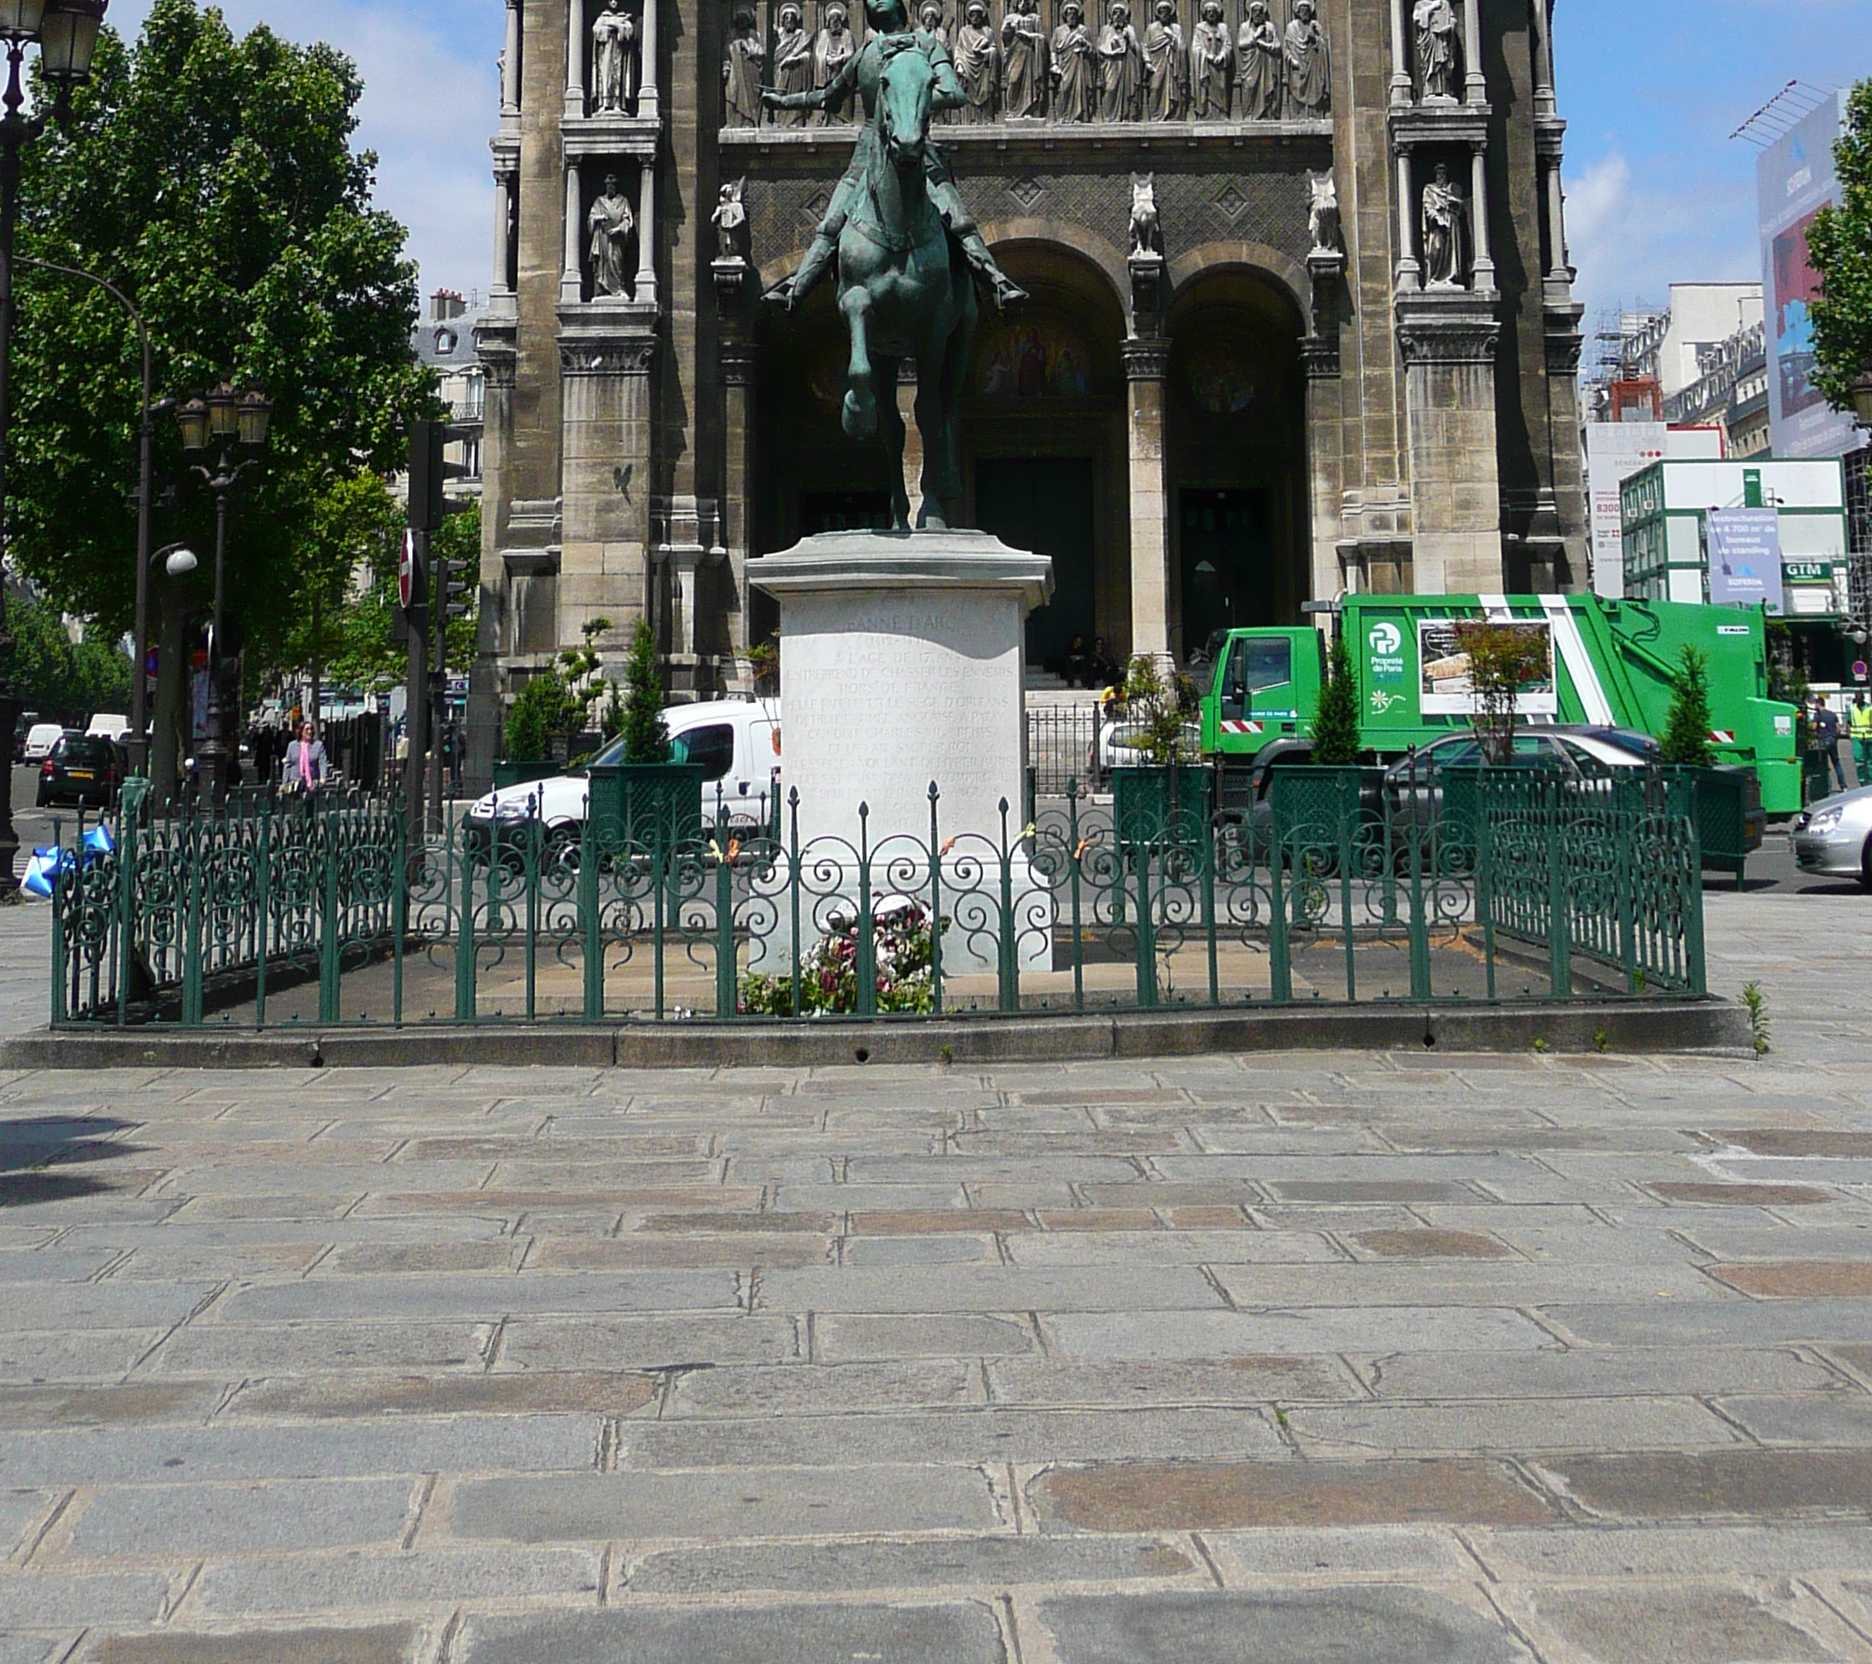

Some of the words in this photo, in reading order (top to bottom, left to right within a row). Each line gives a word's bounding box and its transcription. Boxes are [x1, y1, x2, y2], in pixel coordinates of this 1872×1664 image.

[1723, 524, 1730, 533] 4
[1732, 524, 1749, 533] 700
[1764, 524, 1776, 533] de
[1725, 535, 1761, 544] bureaux
[1732, 546, 1770, 556] standing
[1786, 564, 1822, 575] GTM
[893, 651, 911, 665] DE
[1370, 656, 1404, 666] Propreté
[1384, 665, 1404, 673] Paris
